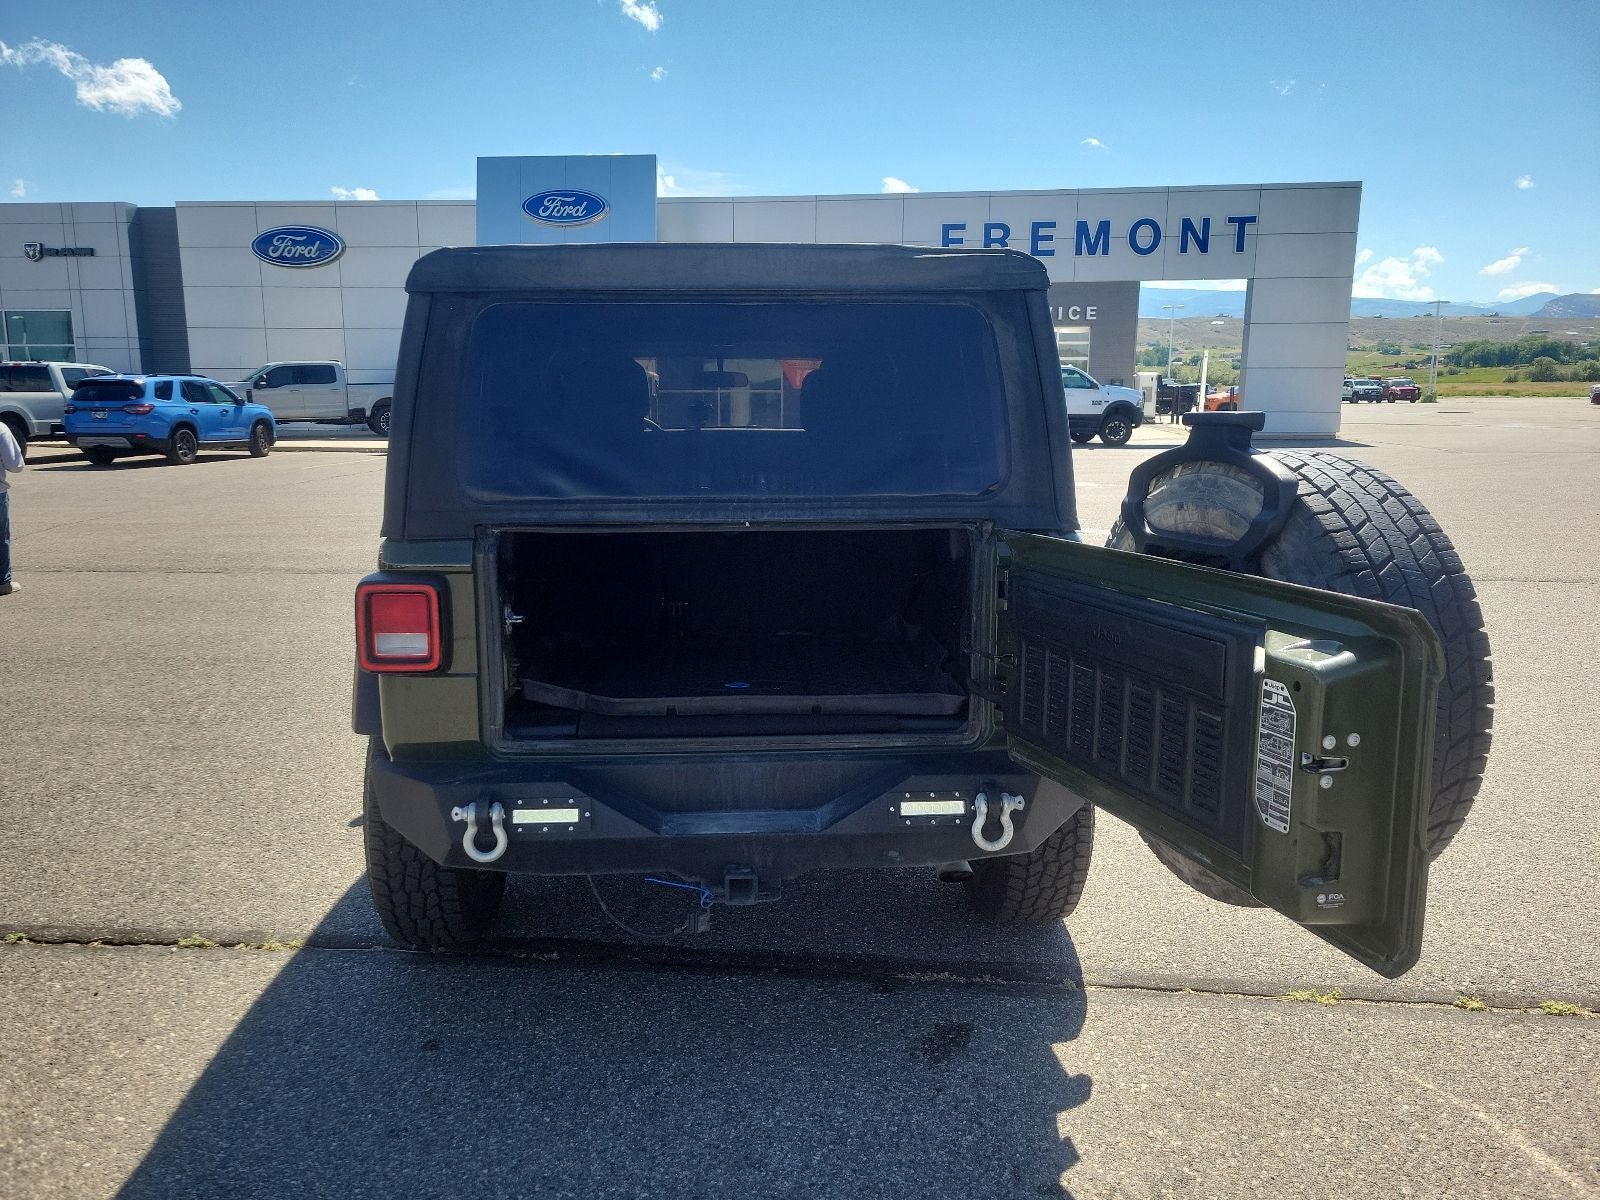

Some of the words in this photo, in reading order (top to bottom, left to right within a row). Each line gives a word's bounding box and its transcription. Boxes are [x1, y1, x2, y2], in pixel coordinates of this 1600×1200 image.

[539, 196, 588, 217] Ford
[268, 234, 321, 258] Ford
[941, 215, 1257, 257] FREMONT
